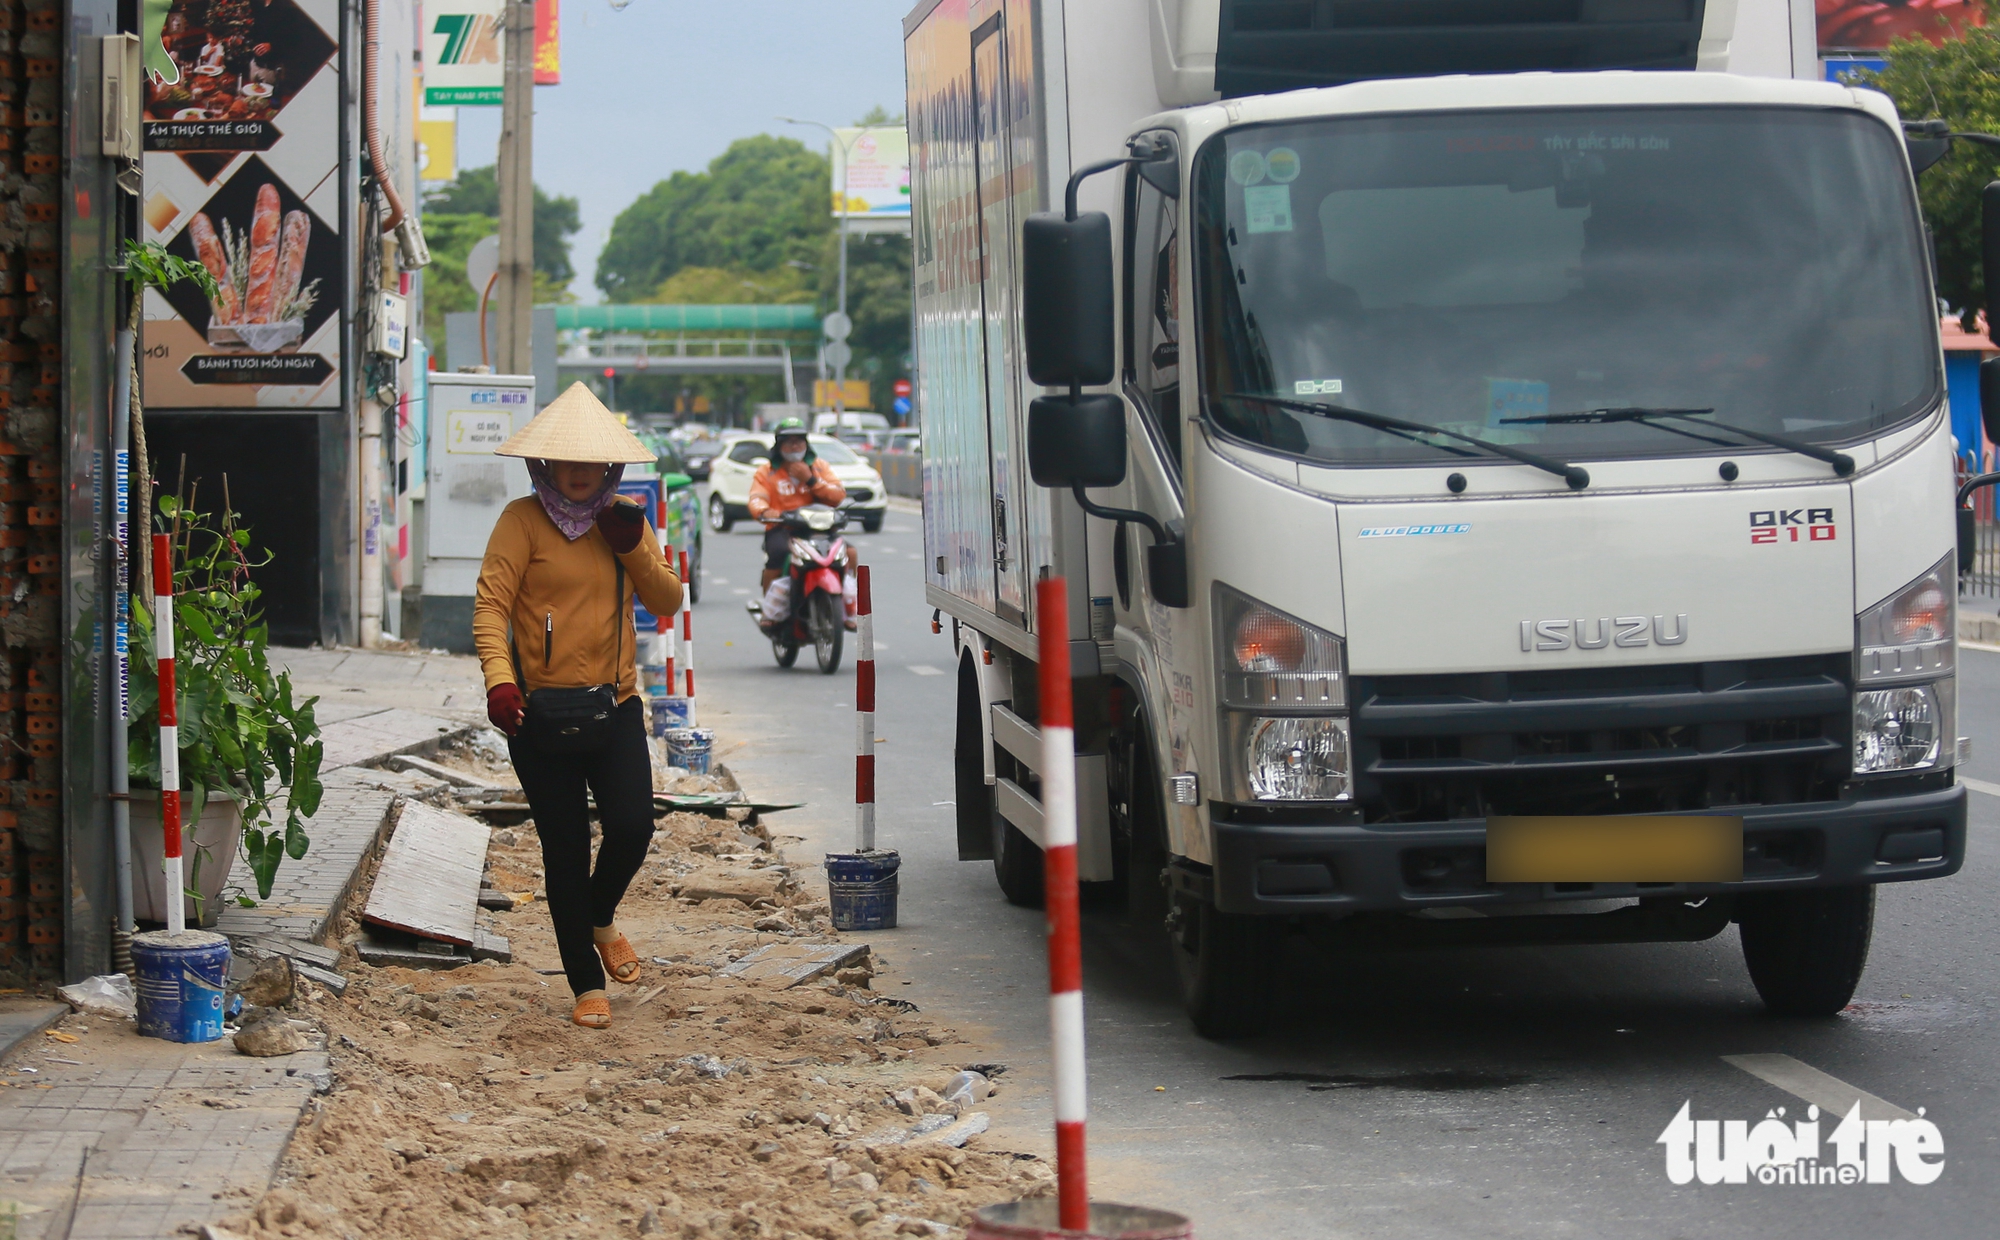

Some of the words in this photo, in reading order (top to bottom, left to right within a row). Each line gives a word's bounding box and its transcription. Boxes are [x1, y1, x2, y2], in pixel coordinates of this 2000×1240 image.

[171, 124, 205, 138] THỰC
[207, 121, 233, 135] THẾ
[235, 123, 262, 135] GIỚI
[1543, 134, 1572, 150] TÂY
[198, 358, 230, 369] BÁNH
[231, 358, 260, 369] TƯƠI
[284, 358, 317, 369] NGÀY
[1749, 508, 1835, 528] QKR
[1359, 523, 1471, 537] BLUEPOWER
[1751, 525, 1836, 544] 210
[1520, 613, 1689, 652] ISUZU
[1173, 688, 1194, 708] 210
